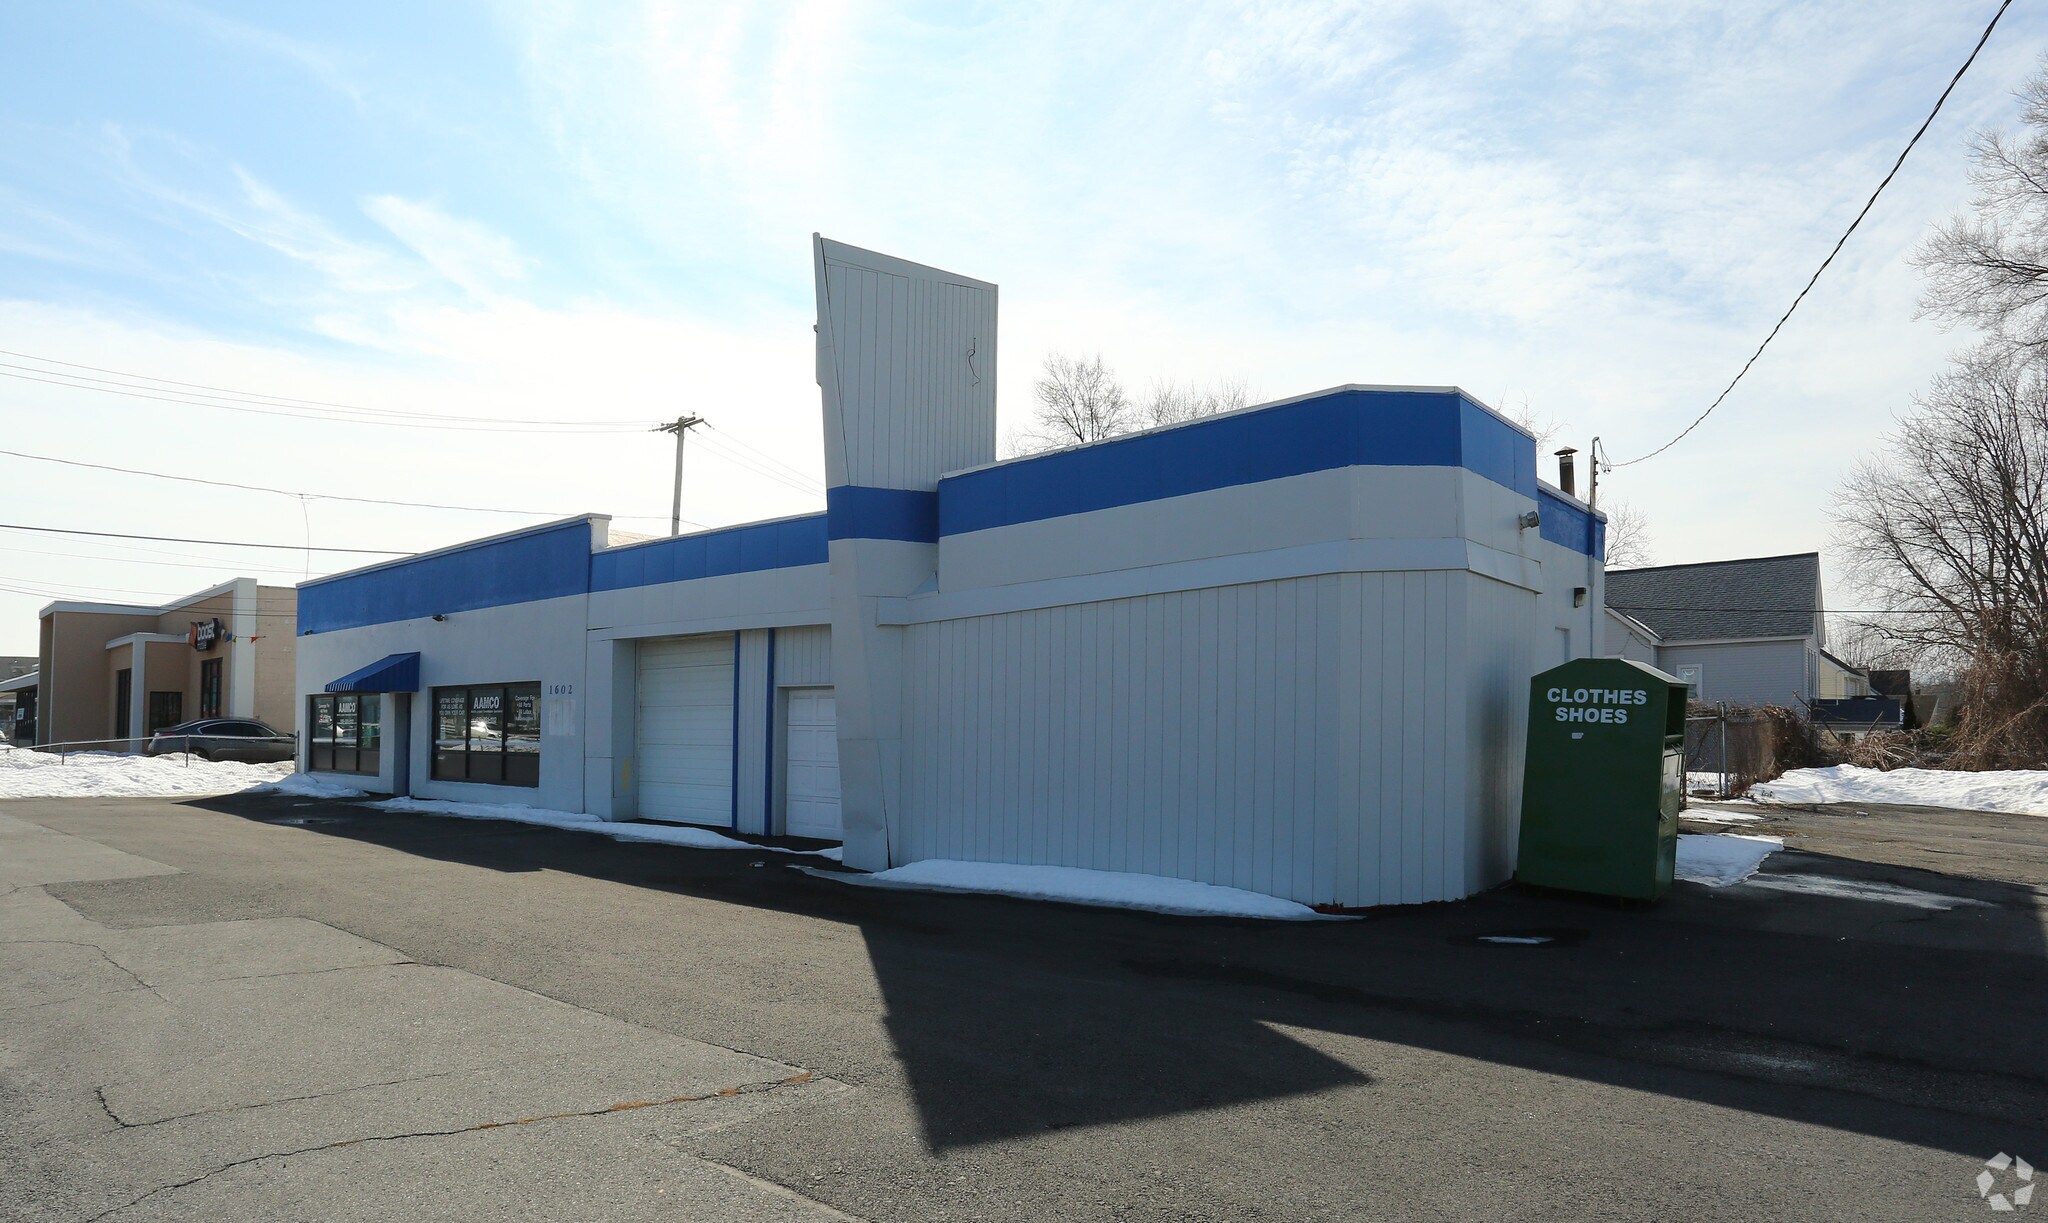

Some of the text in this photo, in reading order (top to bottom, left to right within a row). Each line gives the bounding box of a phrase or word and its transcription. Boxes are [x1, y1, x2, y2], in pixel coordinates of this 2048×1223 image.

[197, 619, 215, 641] boost
[549, 684, 573, 694] 1602
[1547, 687, 1647, 705] CLOTHES
[338, 702, 356, 713] AAMCO
[473, 696, 500, 709] AAMCO
[1555, 707, 1628, 724] SHOES
